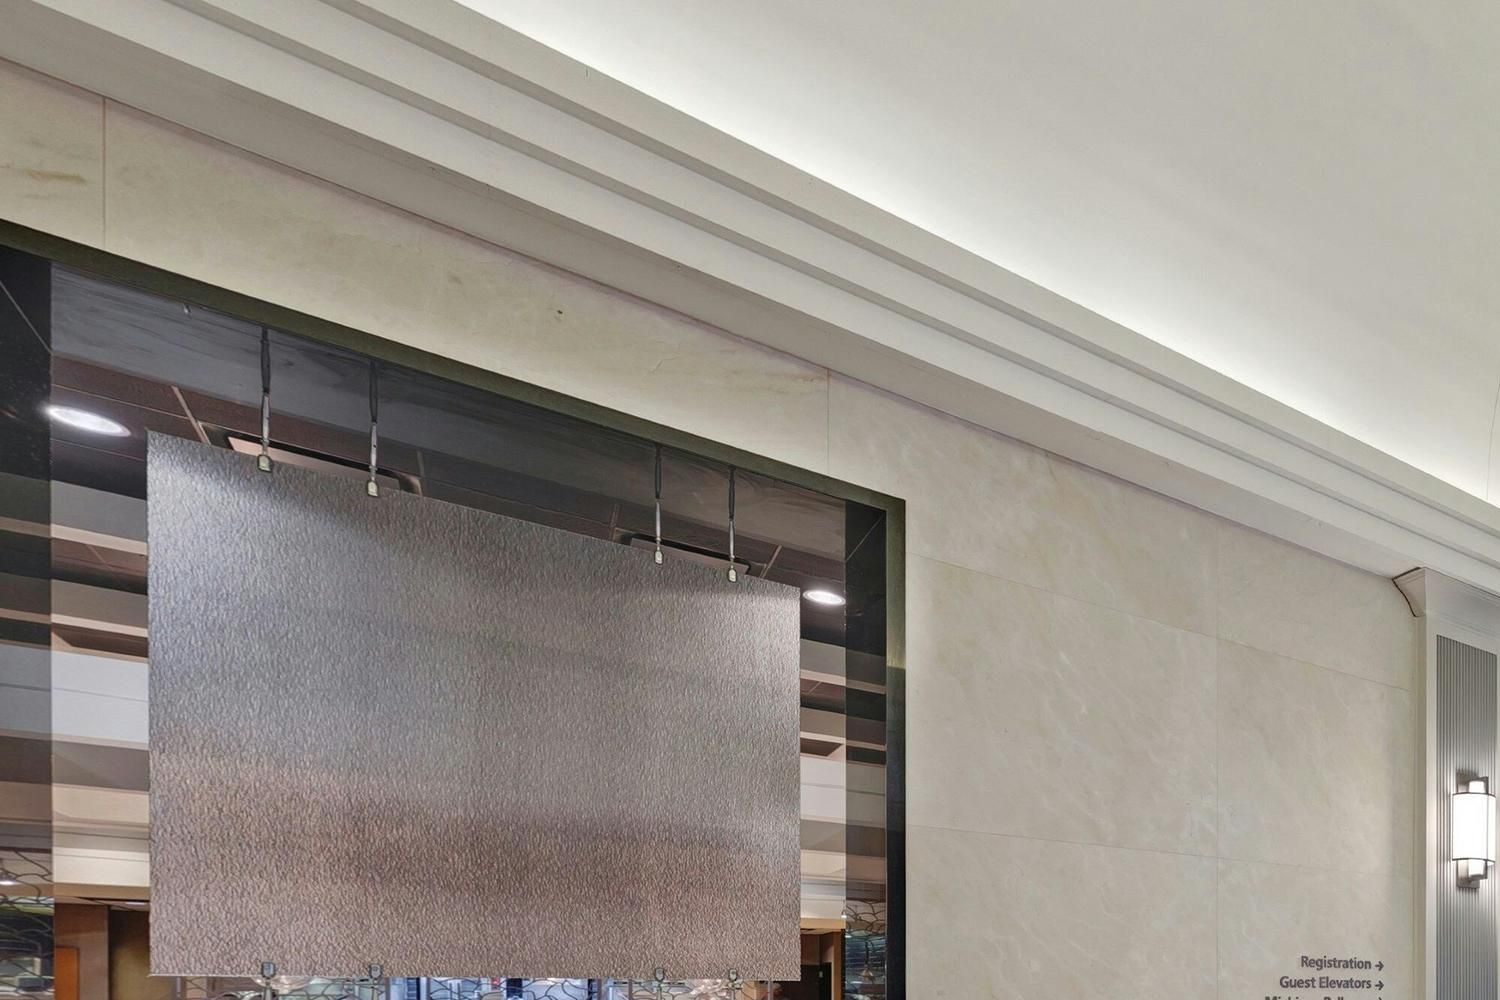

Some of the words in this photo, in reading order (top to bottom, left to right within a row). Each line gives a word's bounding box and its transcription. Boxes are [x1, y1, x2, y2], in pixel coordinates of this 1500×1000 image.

[1300, 956, 1372, 971] Registration
[1279, 976, 1316, 989] Guest
[1319, 976, 1372, 989] Elevators
